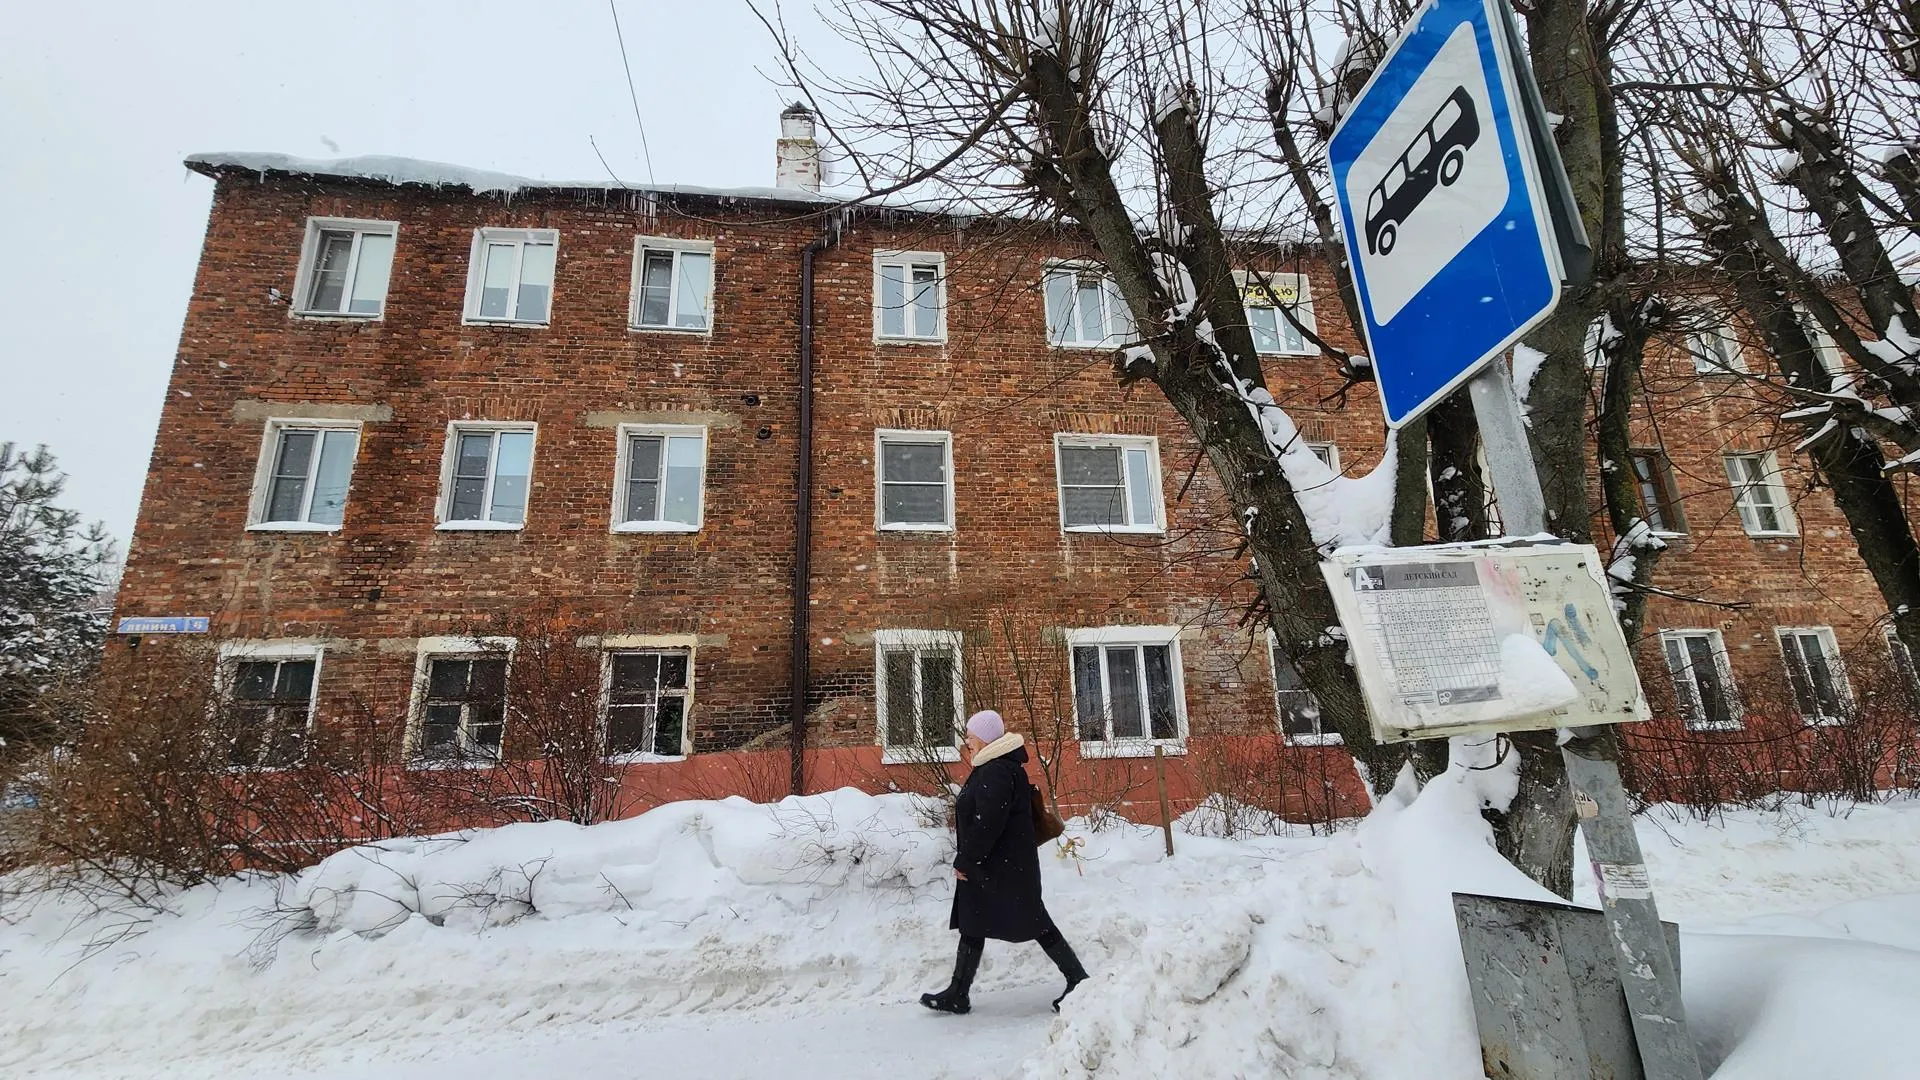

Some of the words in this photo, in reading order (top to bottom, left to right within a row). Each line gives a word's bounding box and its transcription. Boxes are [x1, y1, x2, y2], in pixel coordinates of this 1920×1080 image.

[1404, 570, 1440, 580] ДЕТСКИЙ
[1441, 570, 1458, 580] САД
[127, 623, 176, 632] ЛЕНИНА
